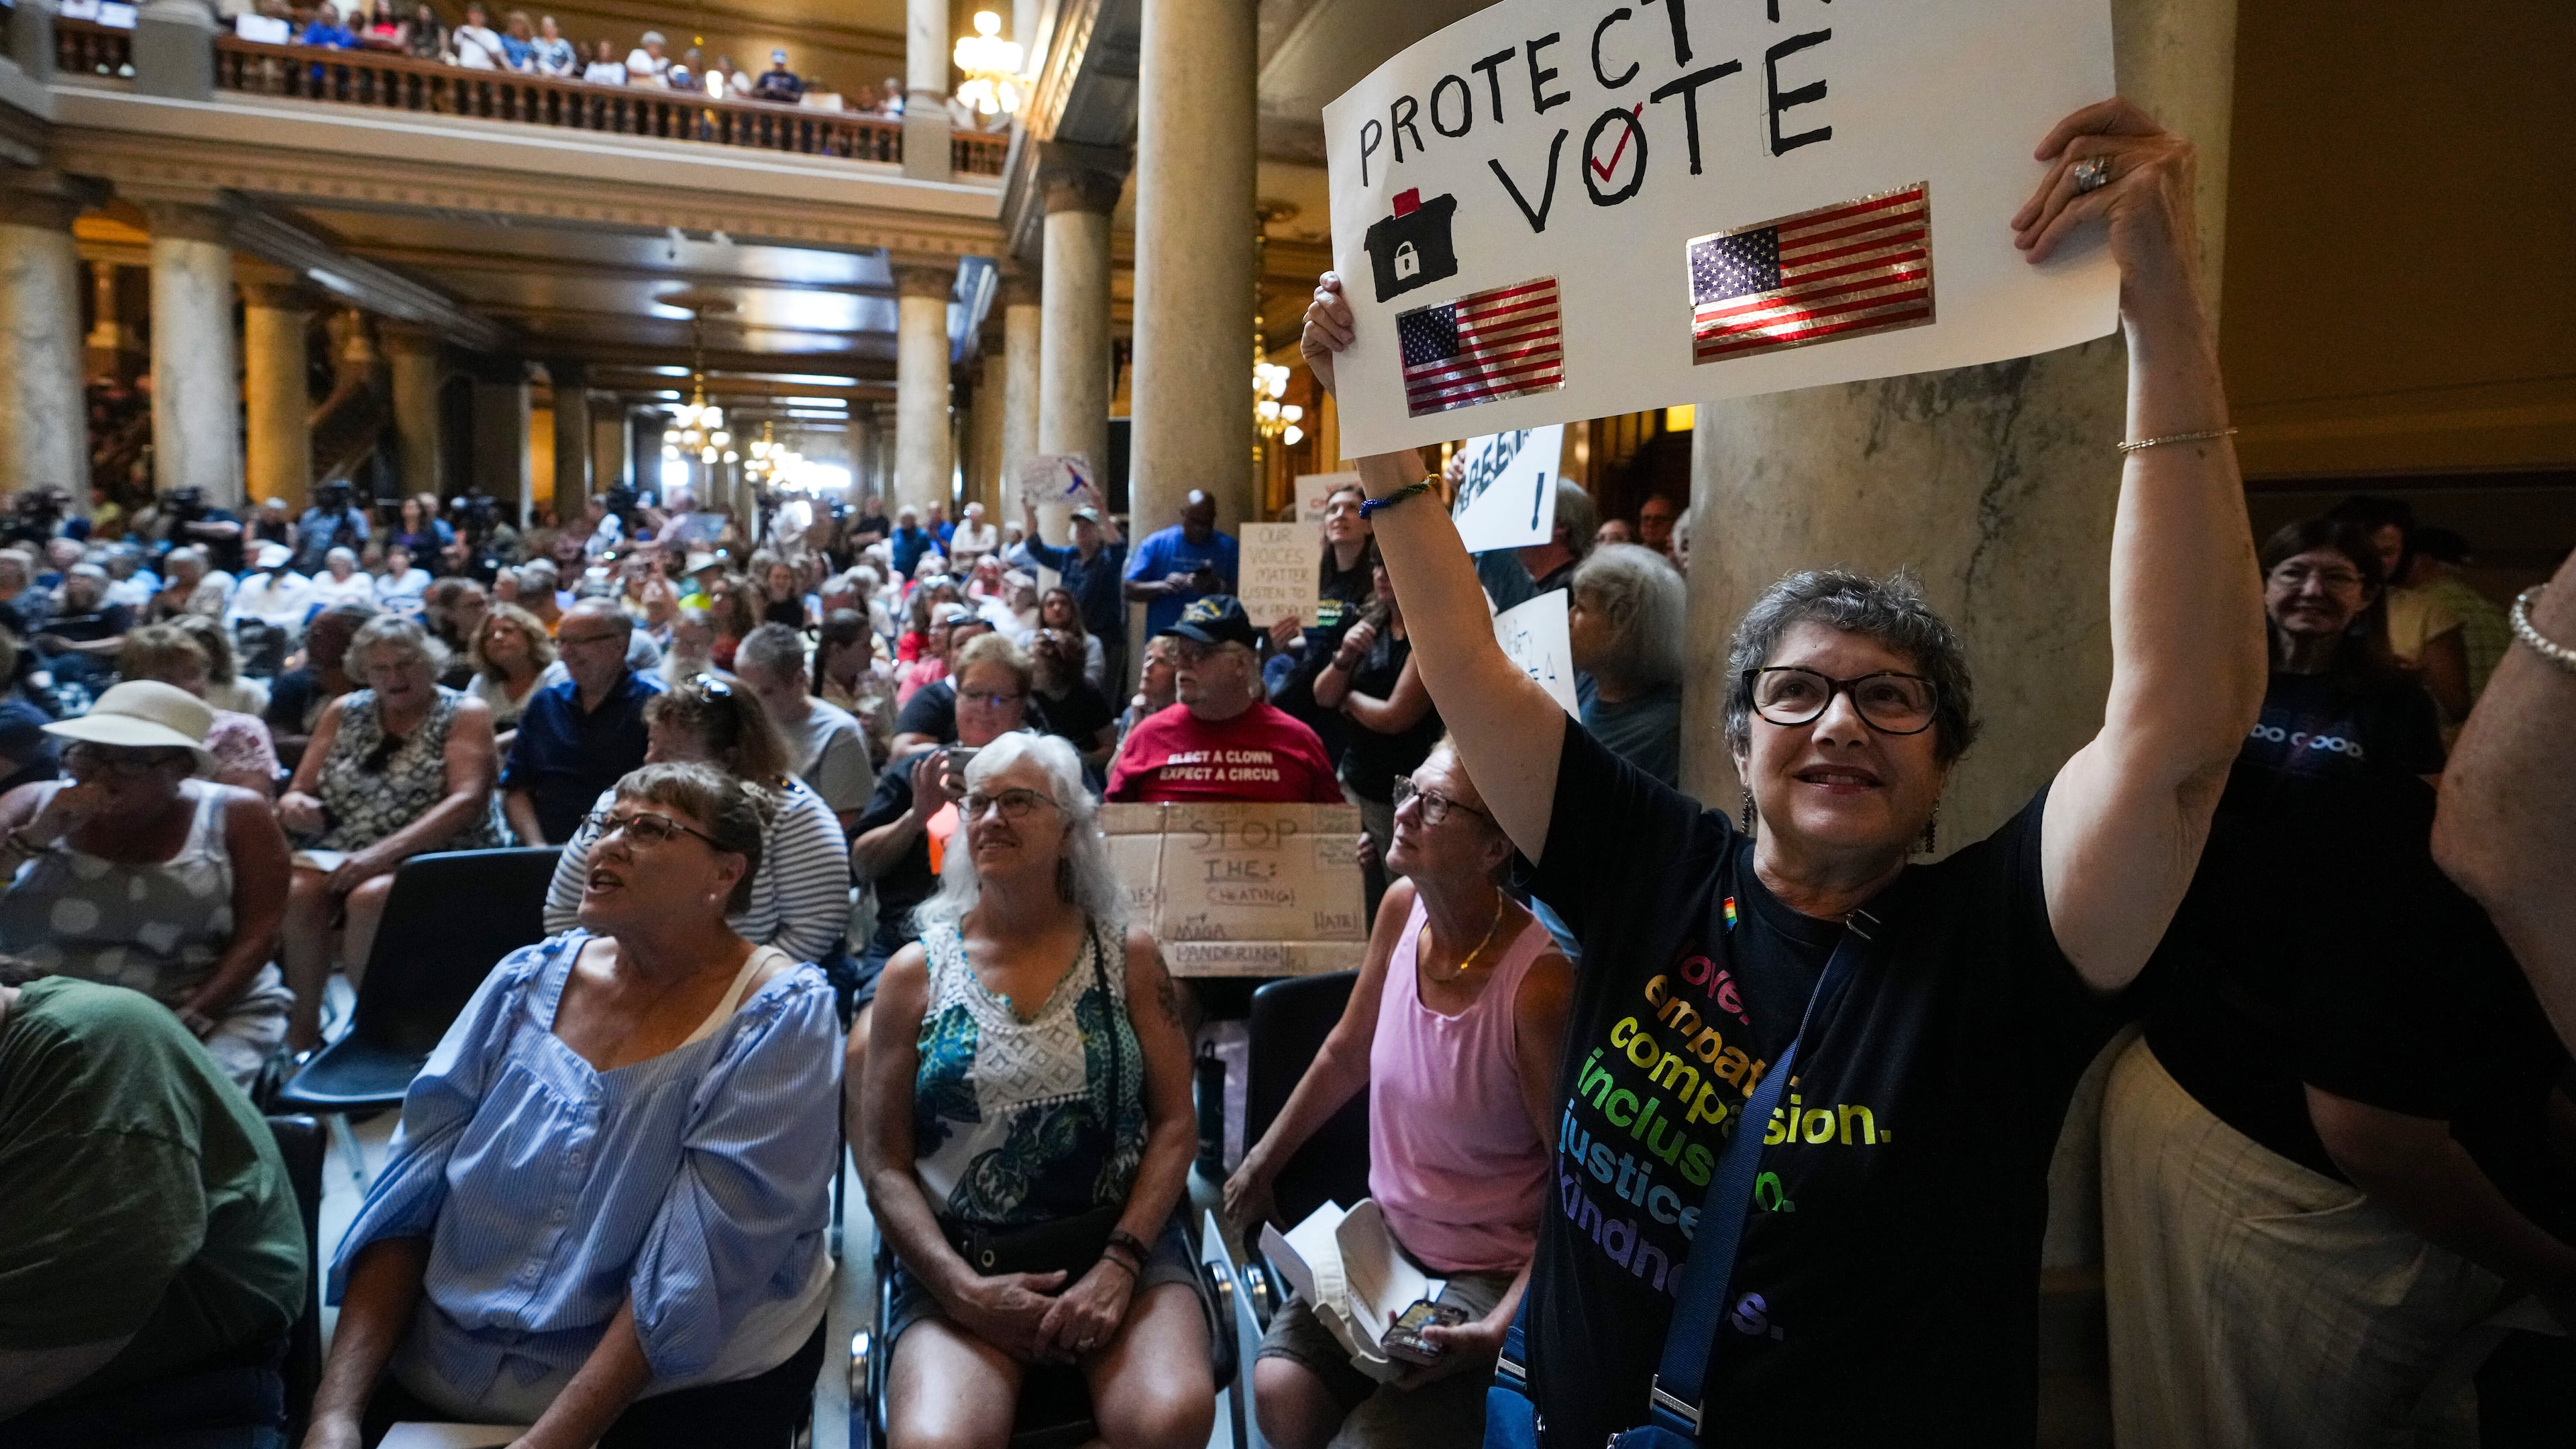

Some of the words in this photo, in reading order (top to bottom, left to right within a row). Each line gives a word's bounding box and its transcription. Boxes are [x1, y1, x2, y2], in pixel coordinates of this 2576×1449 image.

[1362, 0, 1693, 186] PROTECT
[1489, 28, 1832, 233] VOTE
[1248, 547, 1305, 564] VOICES
[1159, 767, 1213, 780] EXPECT
[1215, 767, 1225, 781] A
[1228, 767, 1280, 782] CIRCUS
[1167, 751, 1210, 765] ELECT
[1213, 750, 1223, 763] A
[1226, 750, 1273, 763] CLOWN
[1190, 818, 1297, 850] STOP
[1680, 955, 1750, 1025] ove.
[1578, 1047, 1796, 1212] inclusn.
